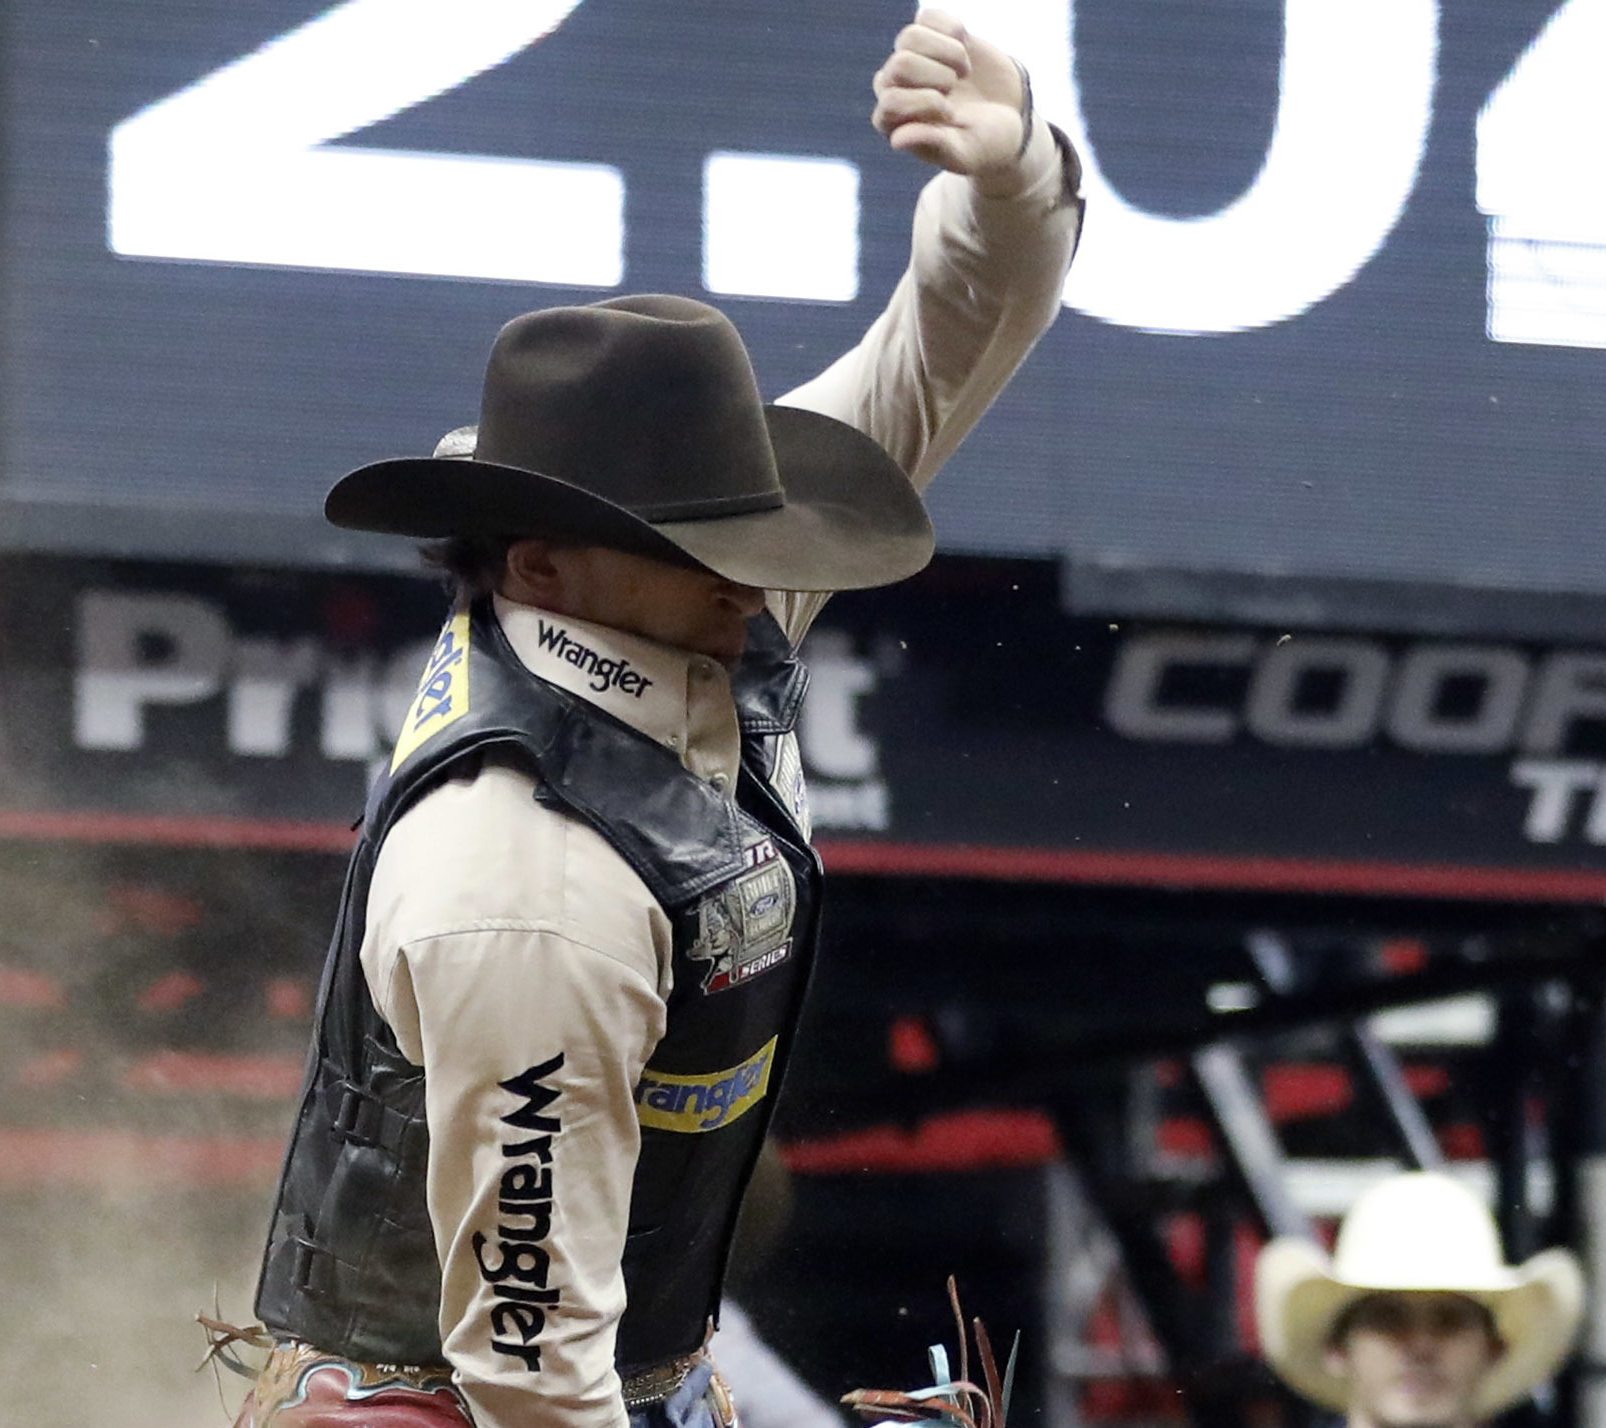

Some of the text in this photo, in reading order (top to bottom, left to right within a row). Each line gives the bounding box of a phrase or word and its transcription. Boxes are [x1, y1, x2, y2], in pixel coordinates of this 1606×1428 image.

[74, 590, 882, 778] Prit
[537, 618, 654, 699] Wrangler
[636, 1052, 770, 1129] rangler
[473, 1051, 566, 1373] Wrangler
